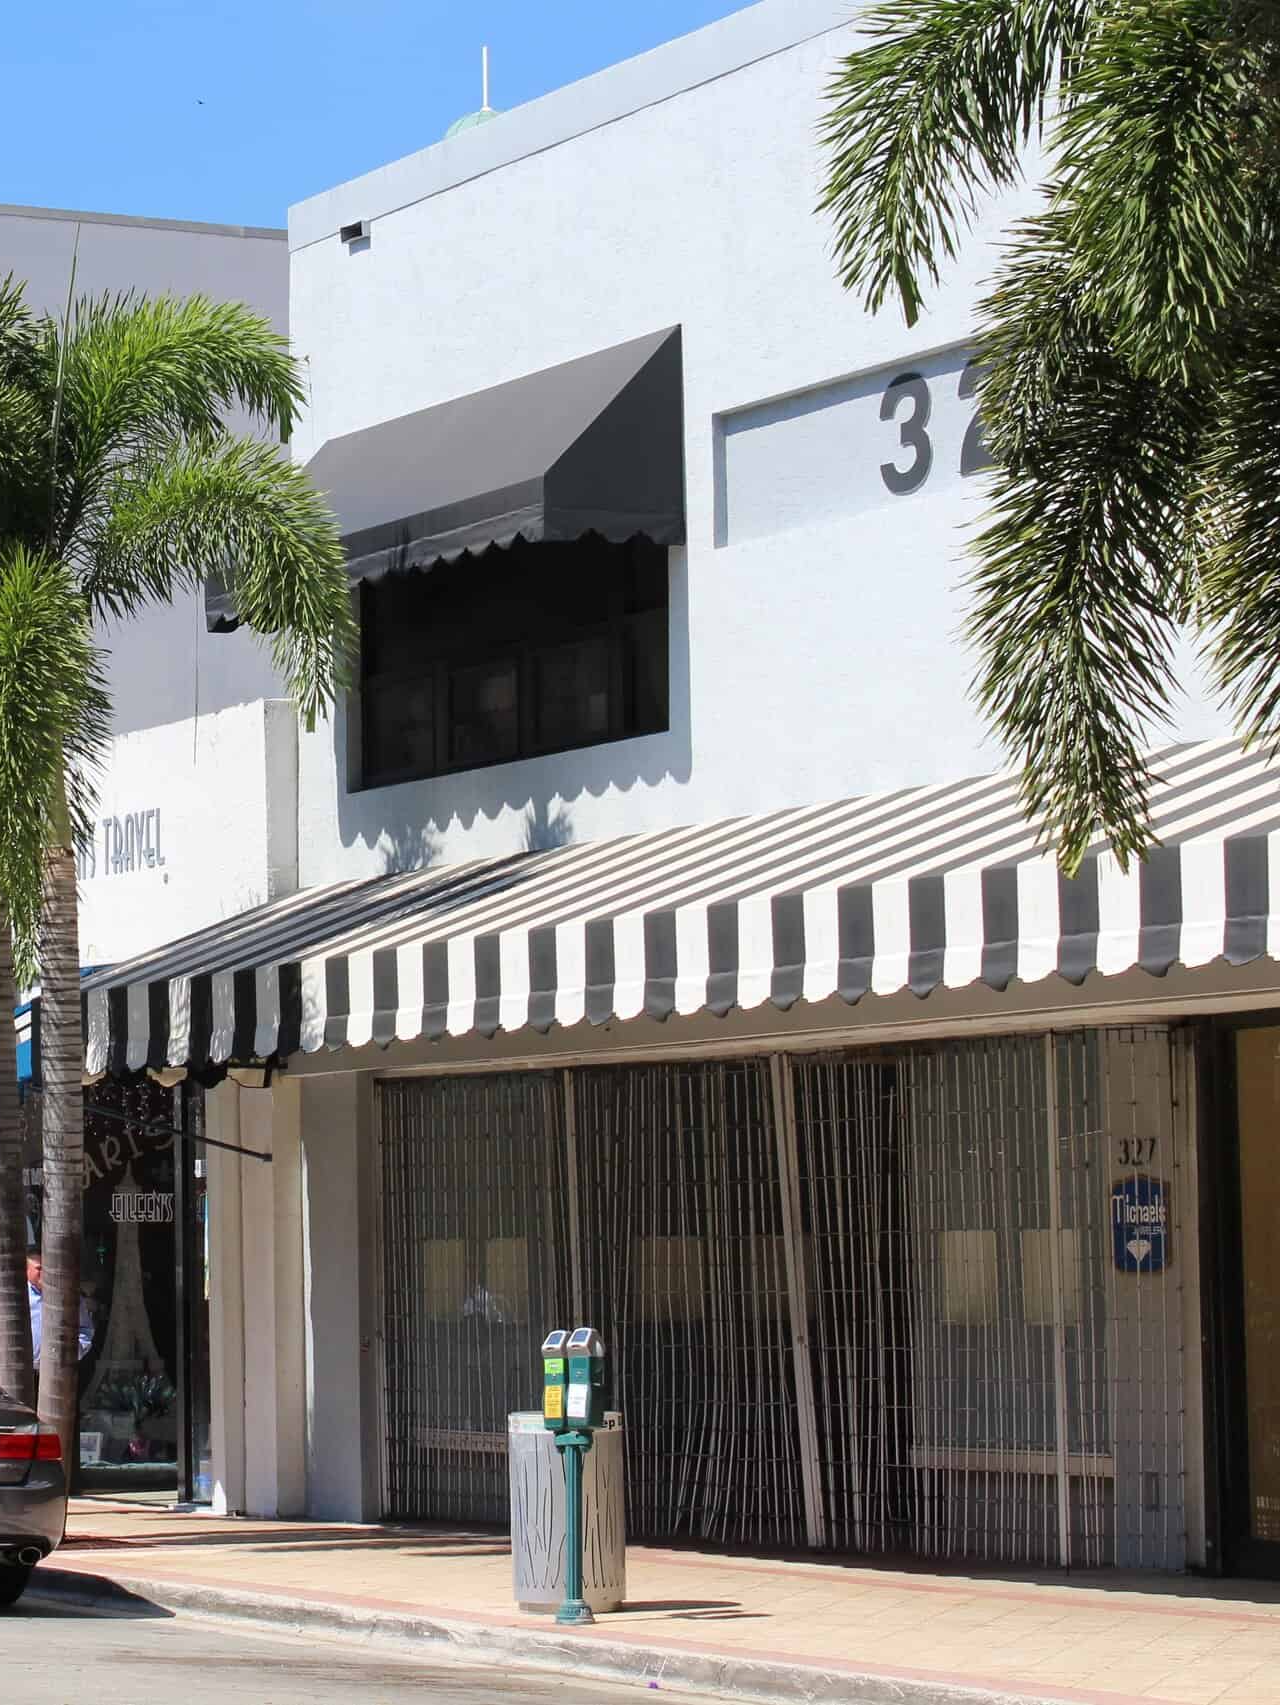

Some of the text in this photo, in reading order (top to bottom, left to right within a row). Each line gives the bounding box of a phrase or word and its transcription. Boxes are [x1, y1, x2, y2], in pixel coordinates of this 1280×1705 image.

[102, 807, 166, 876] TRAVEL
[1118, 1138, 1156, 1165] 327
[108, 1189, 174, 1222] EILEEN'S
